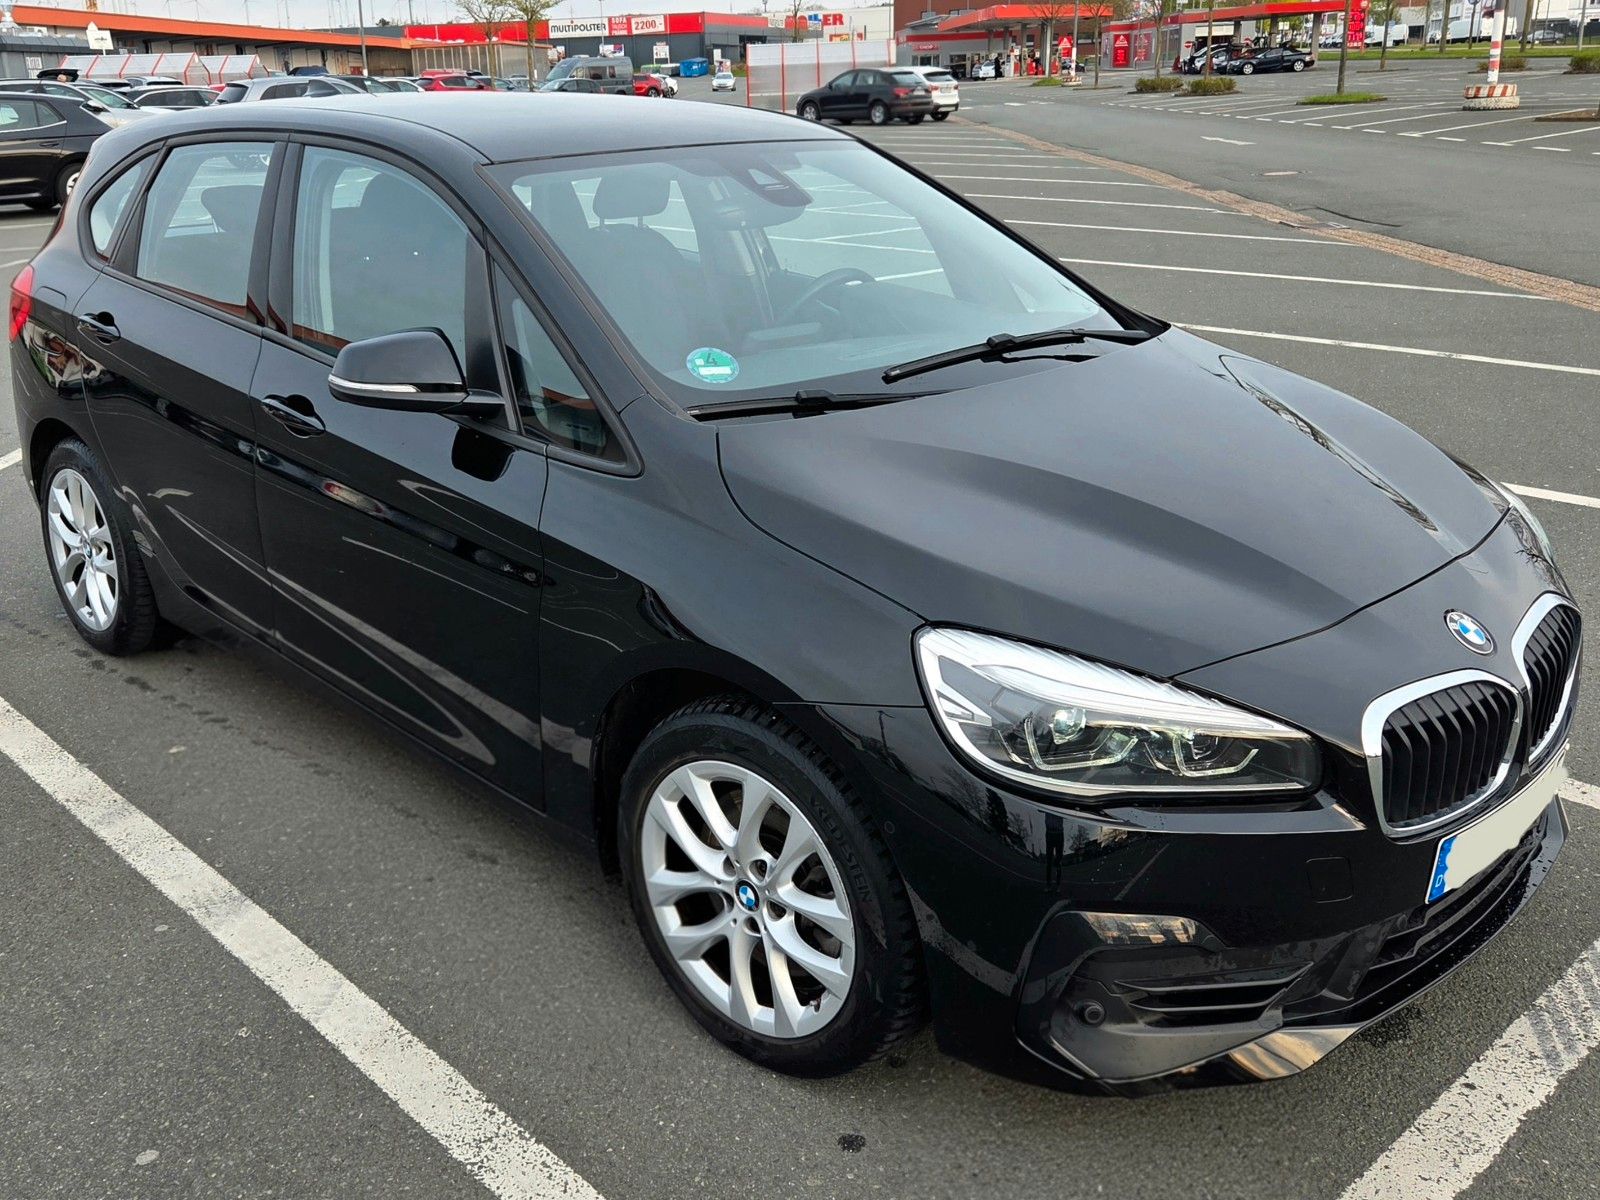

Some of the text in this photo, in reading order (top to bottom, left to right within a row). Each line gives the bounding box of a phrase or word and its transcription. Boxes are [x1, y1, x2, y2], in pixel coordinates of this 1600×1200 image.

[551, 21, 606, 33] MULTIPOLSTER
[706, 352, 718, 366] 4
[1434, 874, 1444, 888] D
